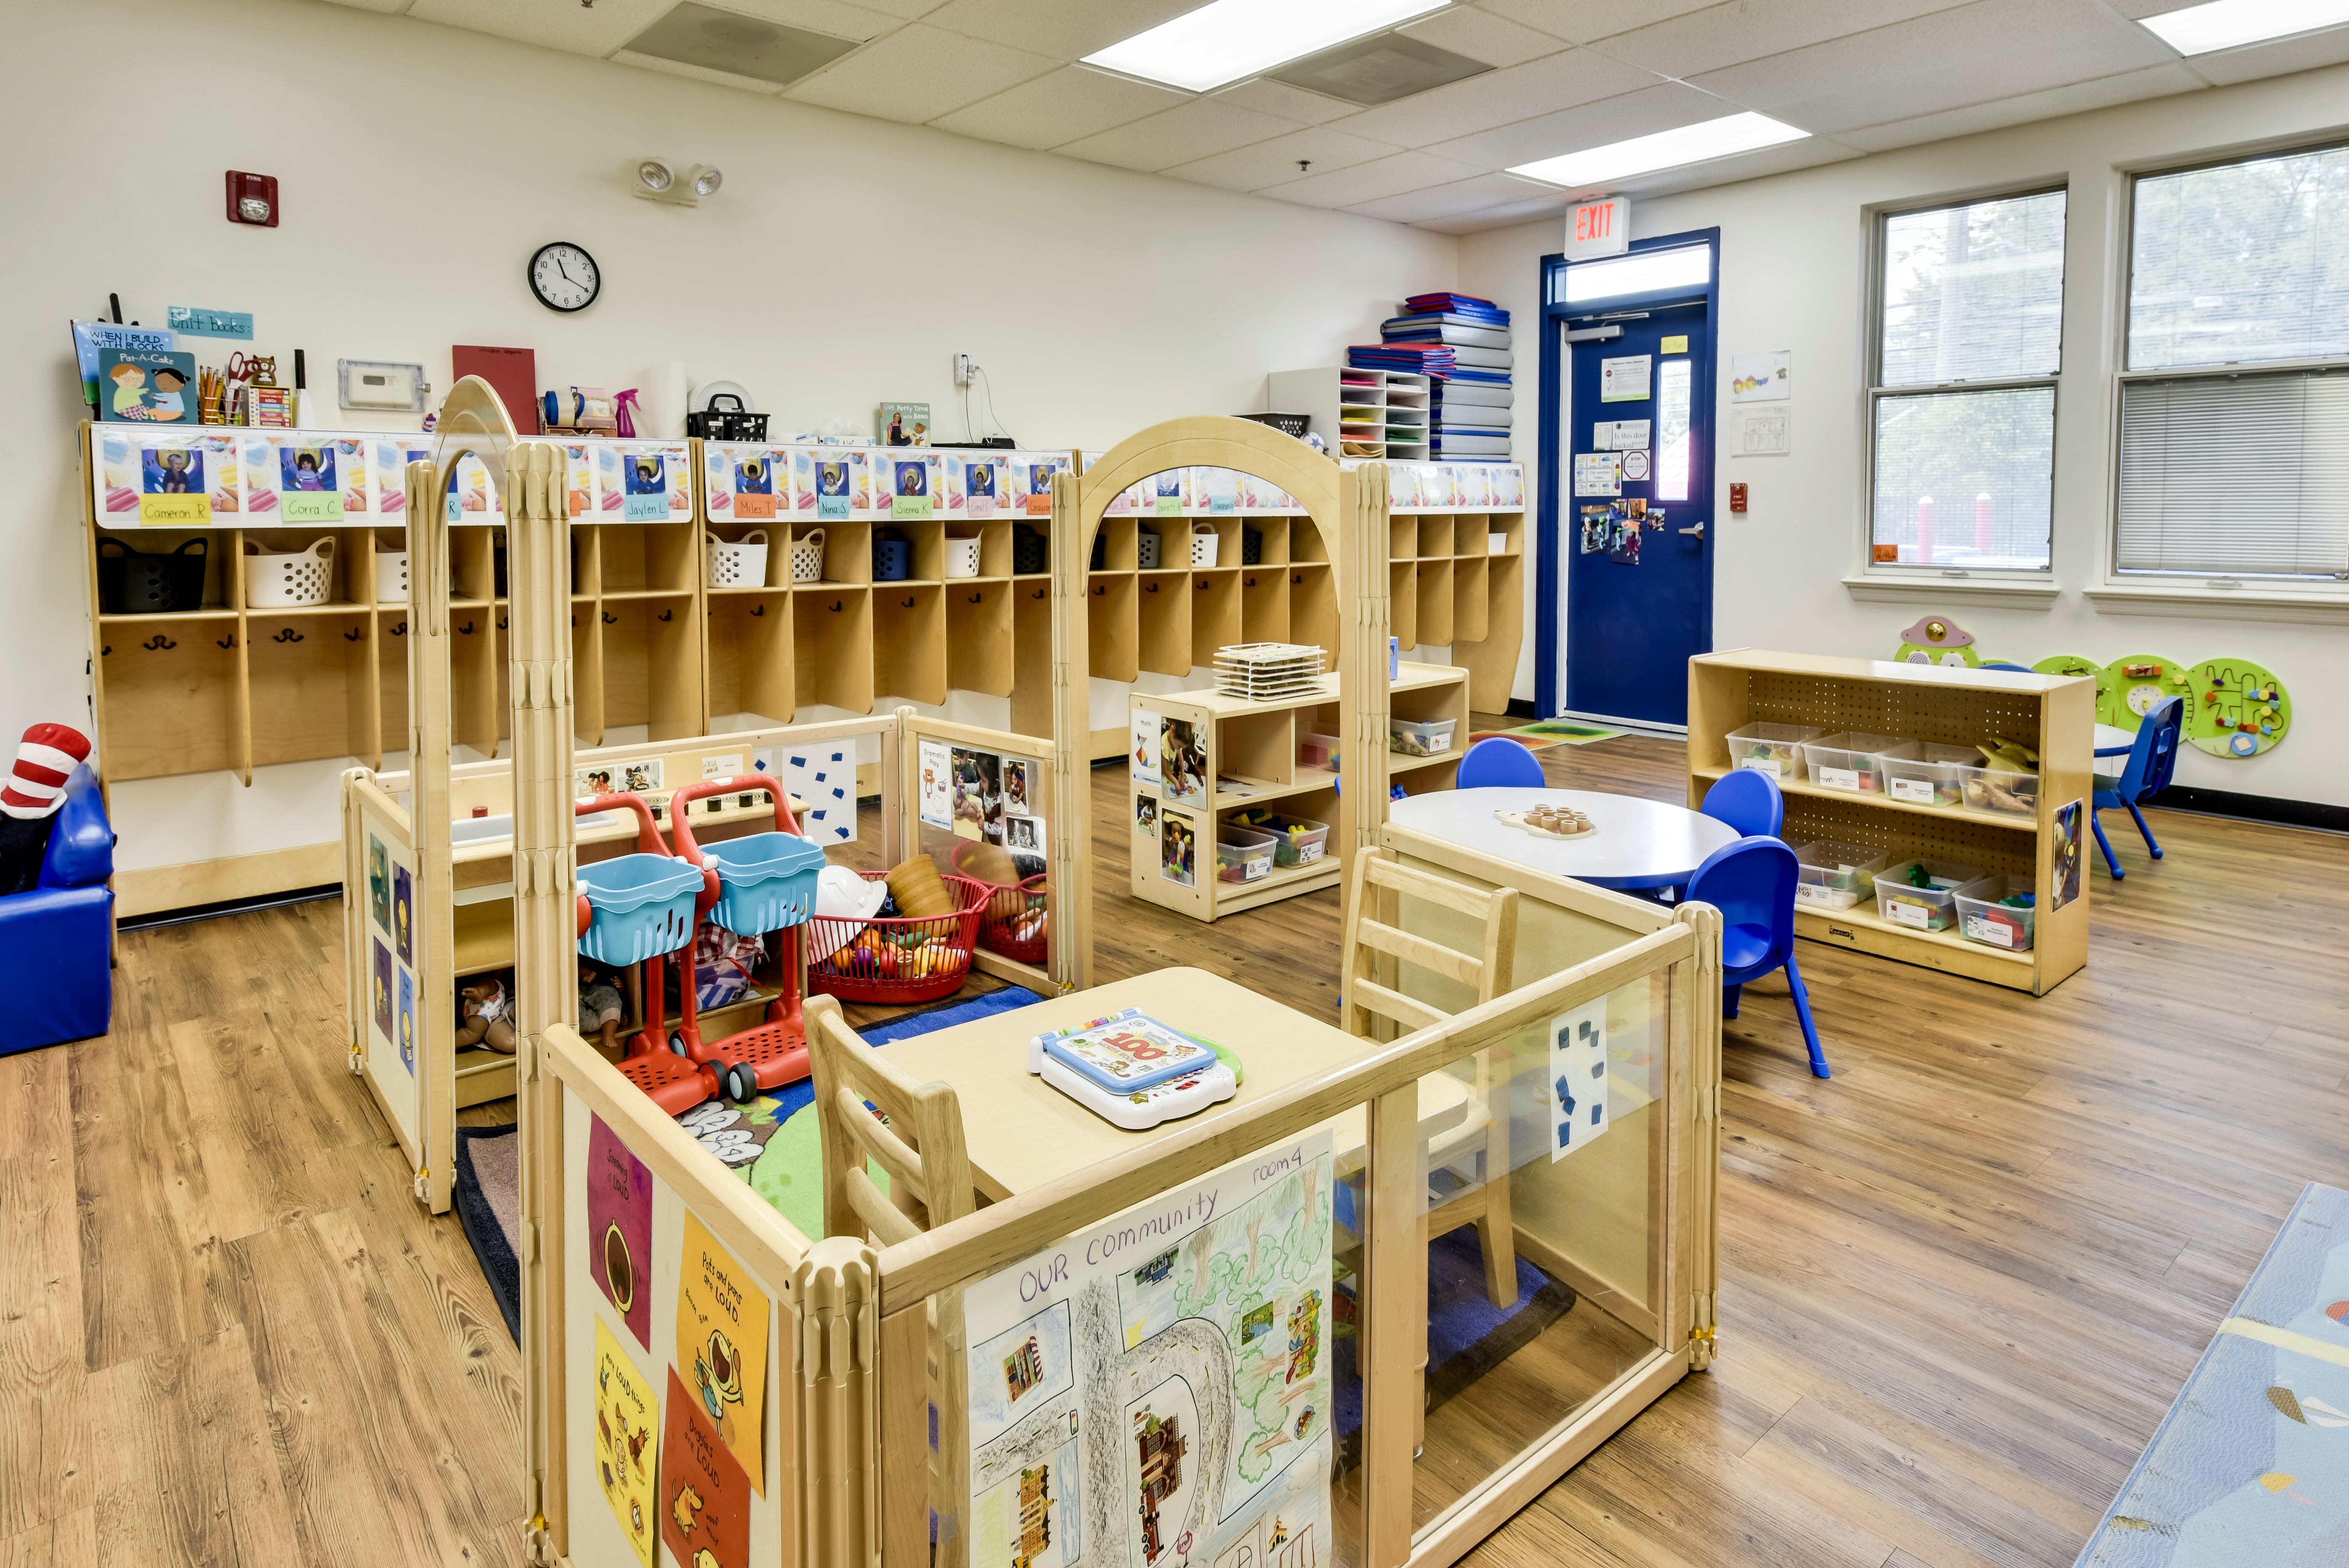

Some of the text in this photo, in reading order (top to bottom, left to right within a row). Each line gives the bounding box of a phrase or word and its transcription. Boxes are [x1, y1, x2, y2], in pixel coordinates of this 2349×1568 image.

[1575, 202, 1614, 242] EXIT
[171, 312, 250, 333] Unit Books:
[90, 330, 122, 340] WHEN
[131, 334, 161, 344] BUILD
[92, 339, 164, 351] WITH BLOCKS
[119, 353, 174, 365] Pat-A-Cake
[897, 405, 913, 413] Potty
[144, 504, 191, 519] Cameron
[289, 499, 320, 515] Corra
[449, 501, 455, 513] R
[628, 502, 656, 517] Jaylen
[741, 501, 762, 514] Miles
[822, 504, 838, 514] Nina
[897, 503, 929, 514] Sienna K
[1030, 503, 1051, 513] Grayson
[1120, 501, 1126, 510] K
[1158, 501, 1182, 512] Everett K
[1875, 552, 1897, 560] Window
[924, 748, 945, 759] Dramatic
[930, 759, 939, 768] Play
[1097, 1041, 1138, 1064] WORDS BOOK
[1102, 1032, 1164, 1060] 100
[706, 1116, 727, 1126] 2
[607, 1148, 628, 1183] Screaming
[607, 1169, 631, 1204] is LOUD.
[1019, 1254, 1069, 1302] OUR
[1253, 1157, 1292, 1186] room
[702, 1251, 743, 1306] Pots and pans
[704, 1274, 740, 1327] are LOUD.
[699, 1314, 709, 1324] BAM
[605, 1352, 645, 1414] More LOUD things
[689, 1415, 714, 1458] Doggies
[684, 1431, 723, 1493] are LOUD.
[635, 1473, 645, 1487] rooster
[706, 1513, 719, 1526] woof
[631, 1532, 639, 1546] alarm
[706, 1526, 720, 1547] woof
